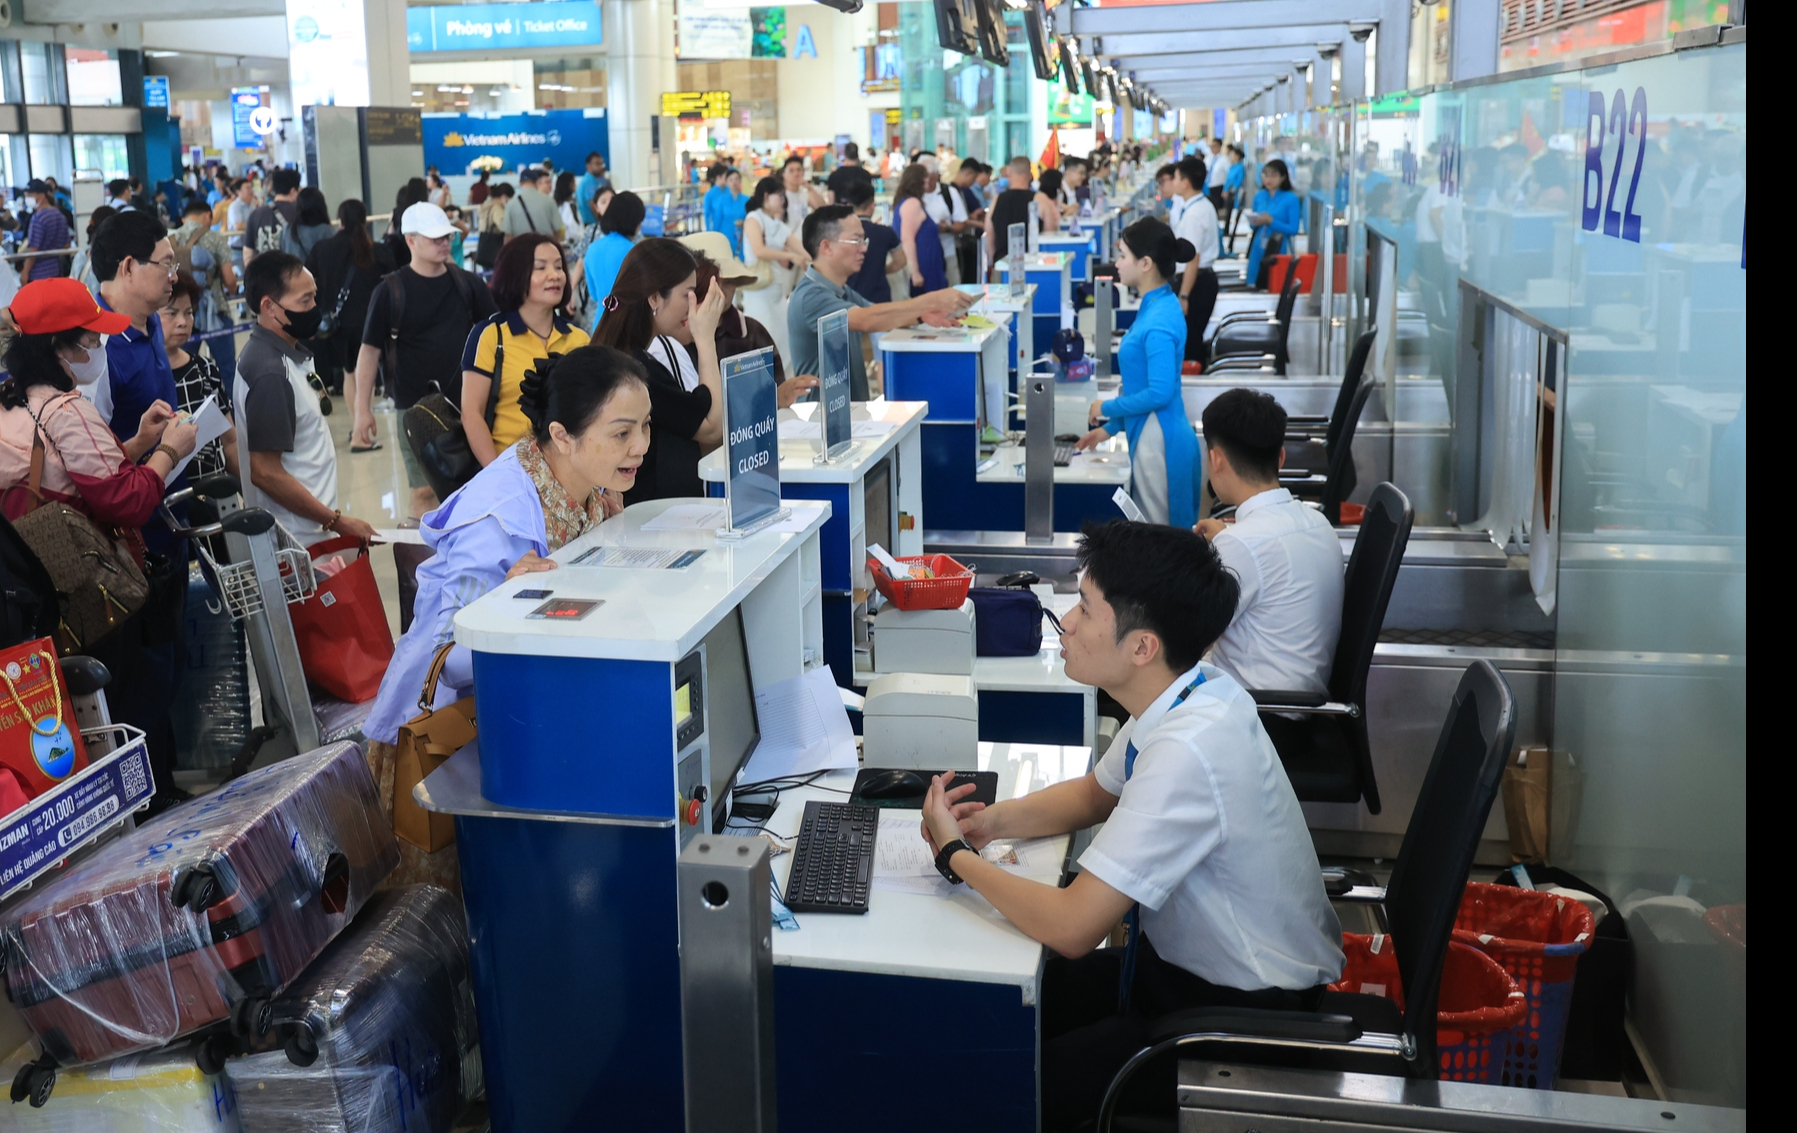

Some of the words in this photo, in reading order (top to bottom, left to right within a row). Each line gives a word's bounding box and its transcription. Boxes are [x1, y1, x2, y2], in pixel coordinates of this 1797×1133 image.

[446, 20, 493, 38] Phòng
[494, 18, 512, 34] vé
[523, 19, 555, 33] Ticket
[556, 18, 588, 32] Office
[793, 24, 818, 59] A
[462, 133, 507, 146] Vietnam
[507, 131, 546, 146] Airlines
[1582, 86, 1647, 244] B22
[829, 394, 846, 413] CLOSED
[730, 425, 754, 447] ĐÓNG
[738, 450, 769, 475] CLOSED
[42, 795, 75, 831] 20.000
[14, 860, 24, 875] HỆ
[23, 850, 44, 870] QUẢNG
[43, 840, 57, 856] CÁO
